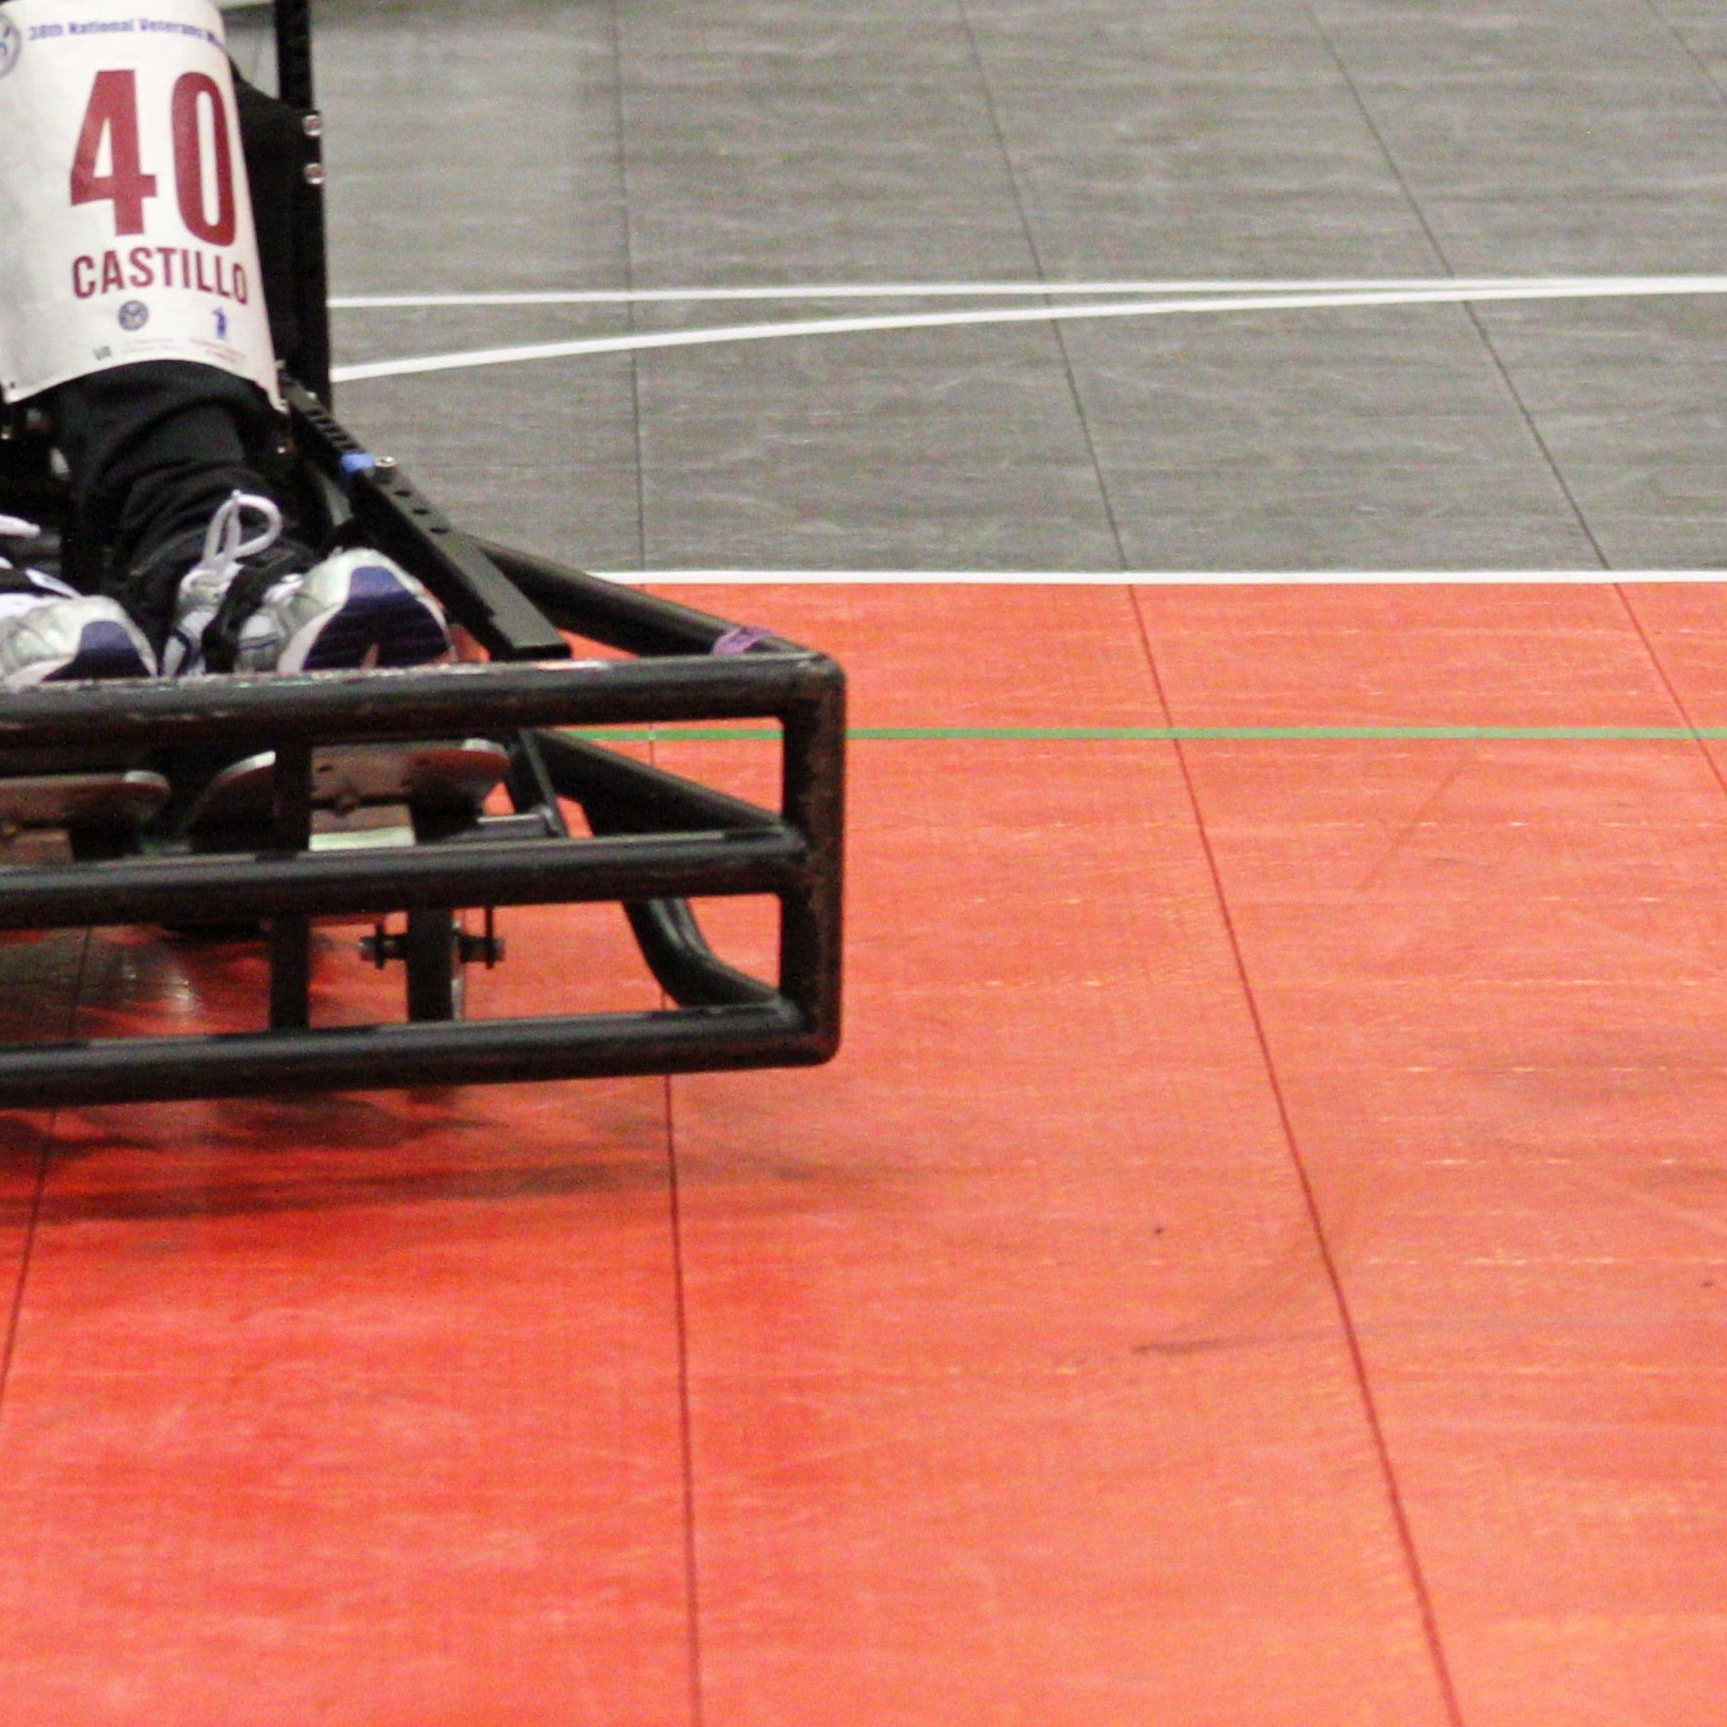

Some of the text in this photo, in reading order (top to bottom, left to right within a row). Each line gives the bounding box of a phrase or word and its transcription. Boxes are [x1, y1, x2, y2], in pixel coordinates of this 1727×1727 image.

[69, 19, 135, 34] National
[140, 18, 205, 40] Veterans
[69, 69, 236, 247] 40
[72, 246, 248, 305] CASTILLO
